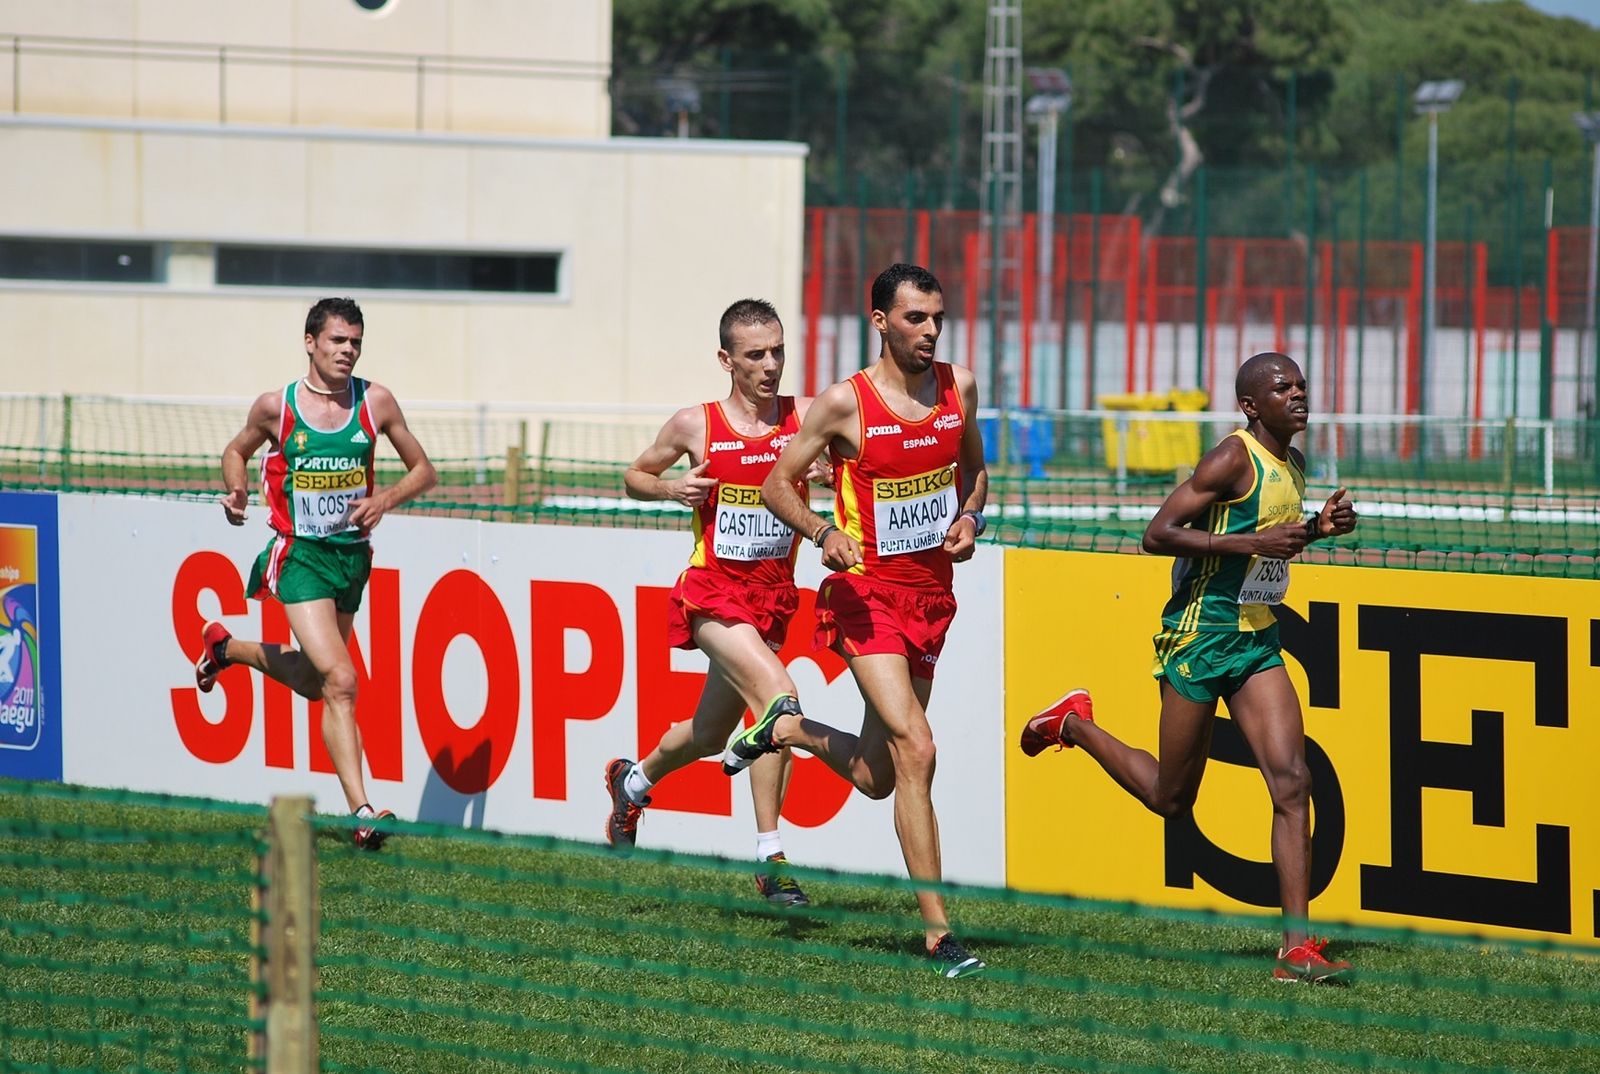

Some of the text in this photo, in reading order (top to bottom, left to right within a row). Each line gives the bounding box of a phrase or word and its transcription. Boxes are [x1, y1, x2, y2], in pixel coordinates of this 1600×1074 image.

[903, 435, 939, 449] ESPAÑA
[295, 457, 361, 471] PORTUGAL
[741, 453, 777, 465] ESPAÑA
[295, 470, 364, 489] SEIKO
[877, 469, 953, 499] SEIKO
[302, 496, 314, 517] N.
[889, 494, 948, 531] AAKAOU
[1268, 503, 1290, 517] SOUTH
[298, 523, 322, 535] PUNTA
[716, 543, 746, 557] PUNTA
[747, 545, 775, 559] UMBRIA
[880, 530, 946, 553] PUNTA UMBRIA
[1255, 560, 1287, 584] TSOS
[1240, 590, 1262, 602] PUNTA
[13, 686, 34, 706] 2011
[0, 702, 35, 733] aegu
[1164, 601, 1600, 938] SE
